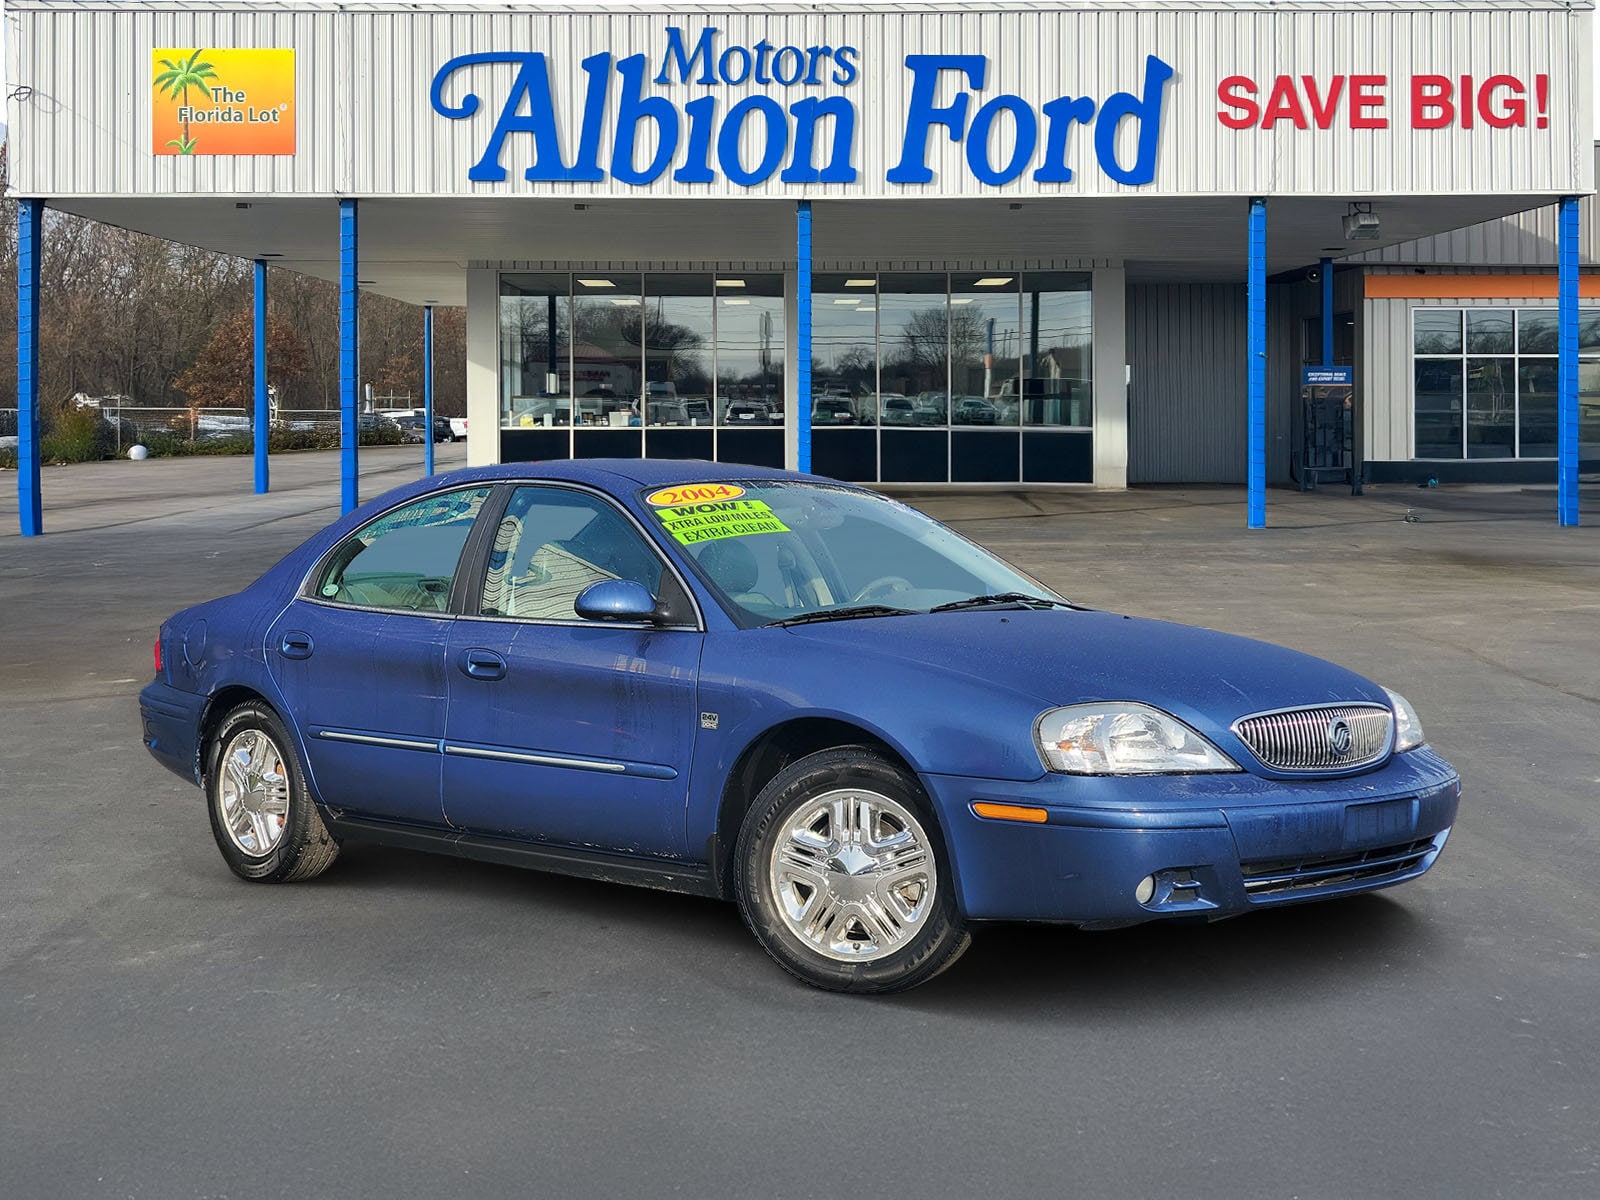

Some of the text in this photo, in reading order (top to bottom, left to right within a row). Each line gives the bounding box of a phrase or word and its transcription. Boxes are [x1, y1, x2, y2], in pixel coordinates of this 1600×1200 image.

[655, 28, 856, 85] Motors
[211, 86, 246, 103] The
[1218, 75, 1548, 129] SAVE BIG!
[178, 106, 279, 123] Florida Lot
[431, 52, 1173, 186] Albion Ford
[662, 485, 731, 504] 2004
[671, 501, 737, 517] WOW
[668, 511, 771, 531] XTRA LOW MILES
[682, 521, 779, 542] EXTRA CLEAN
